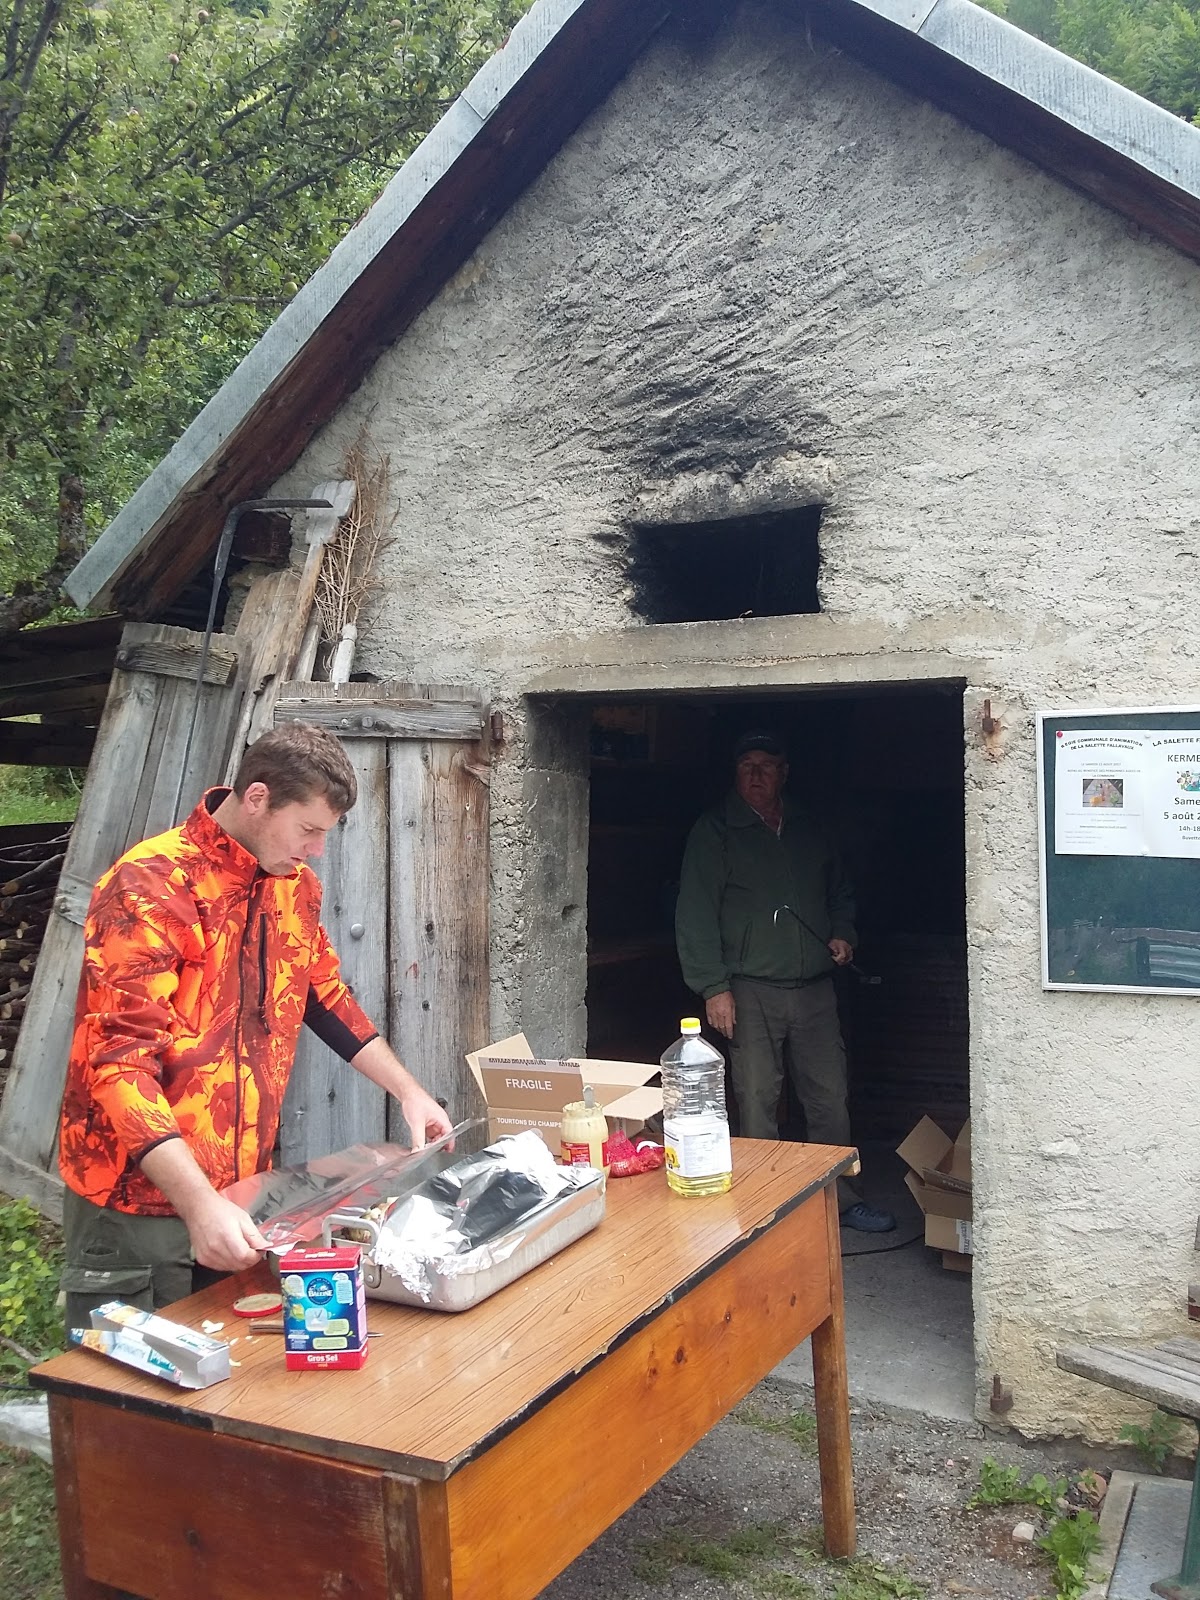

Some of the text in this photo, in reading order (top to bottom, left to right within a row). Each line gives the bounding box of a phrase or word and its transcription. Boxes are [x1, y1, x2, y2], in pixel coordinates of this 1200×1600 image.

[1174, 797, 1200, 805] Same
[1172, 812, 1194, 820] août
[505, 1078, 552, 1090] FRAGILE
[496, 1118, 527, 1126] TOURTONS
